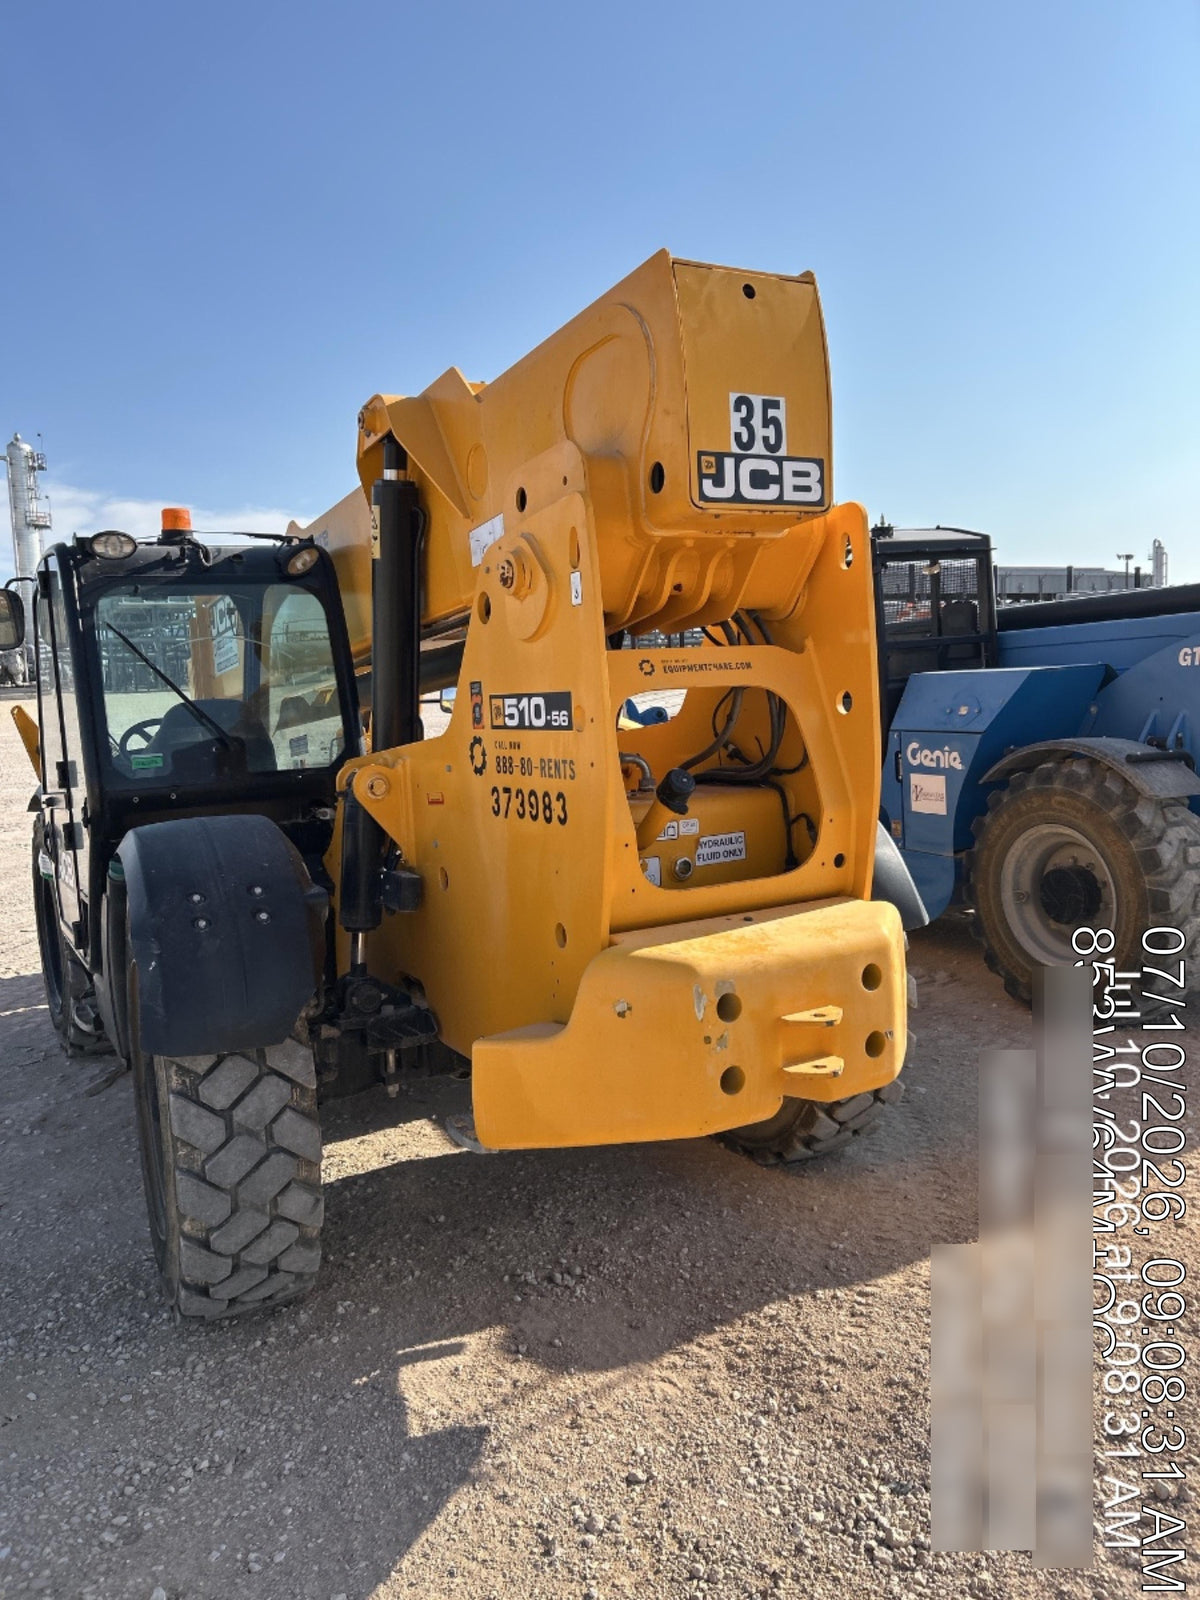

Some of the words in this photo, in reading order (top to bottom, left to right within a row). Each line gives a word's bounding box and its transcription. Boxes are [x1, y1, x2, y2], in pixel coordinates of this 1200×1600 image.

[733, 396, 783, 454] 35
[702, 456, 822, 502] JCB
[495, 756, 576, 780] 888-80-RENTS
[906, 742, 965, 770] Genie
[491, 786, 568, 826] 373983
[697, 850, 721, 862] FLUID
[722, 848, 744, 858] ONLY
